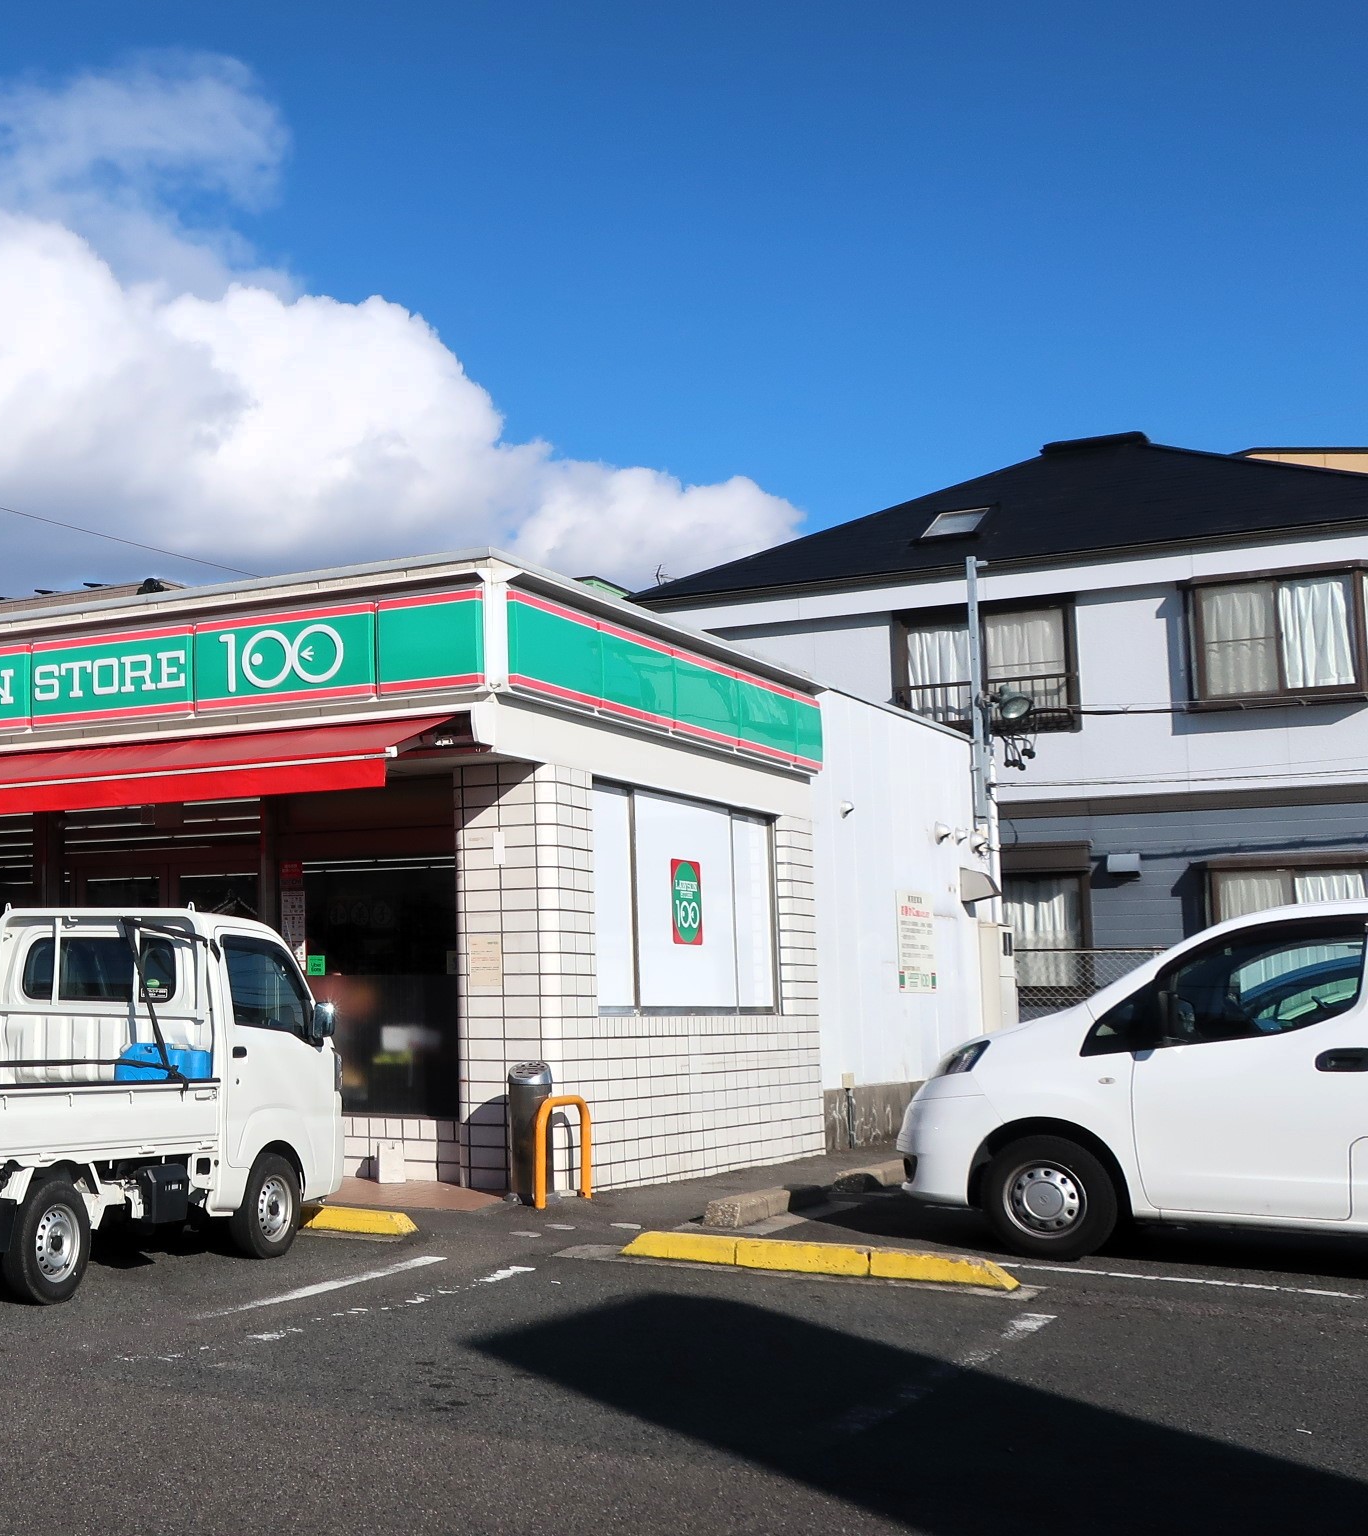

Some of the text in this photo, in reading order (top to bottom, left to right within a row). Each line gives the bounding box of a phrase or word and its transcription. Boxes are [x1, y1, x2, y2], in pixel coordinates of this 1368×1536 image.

[34, 649, 186, 701] STORE
[218, 623, 344, 693] 100
[675, 880, 698, 891] LAWSON
[675, 899, 700, 928] 100
